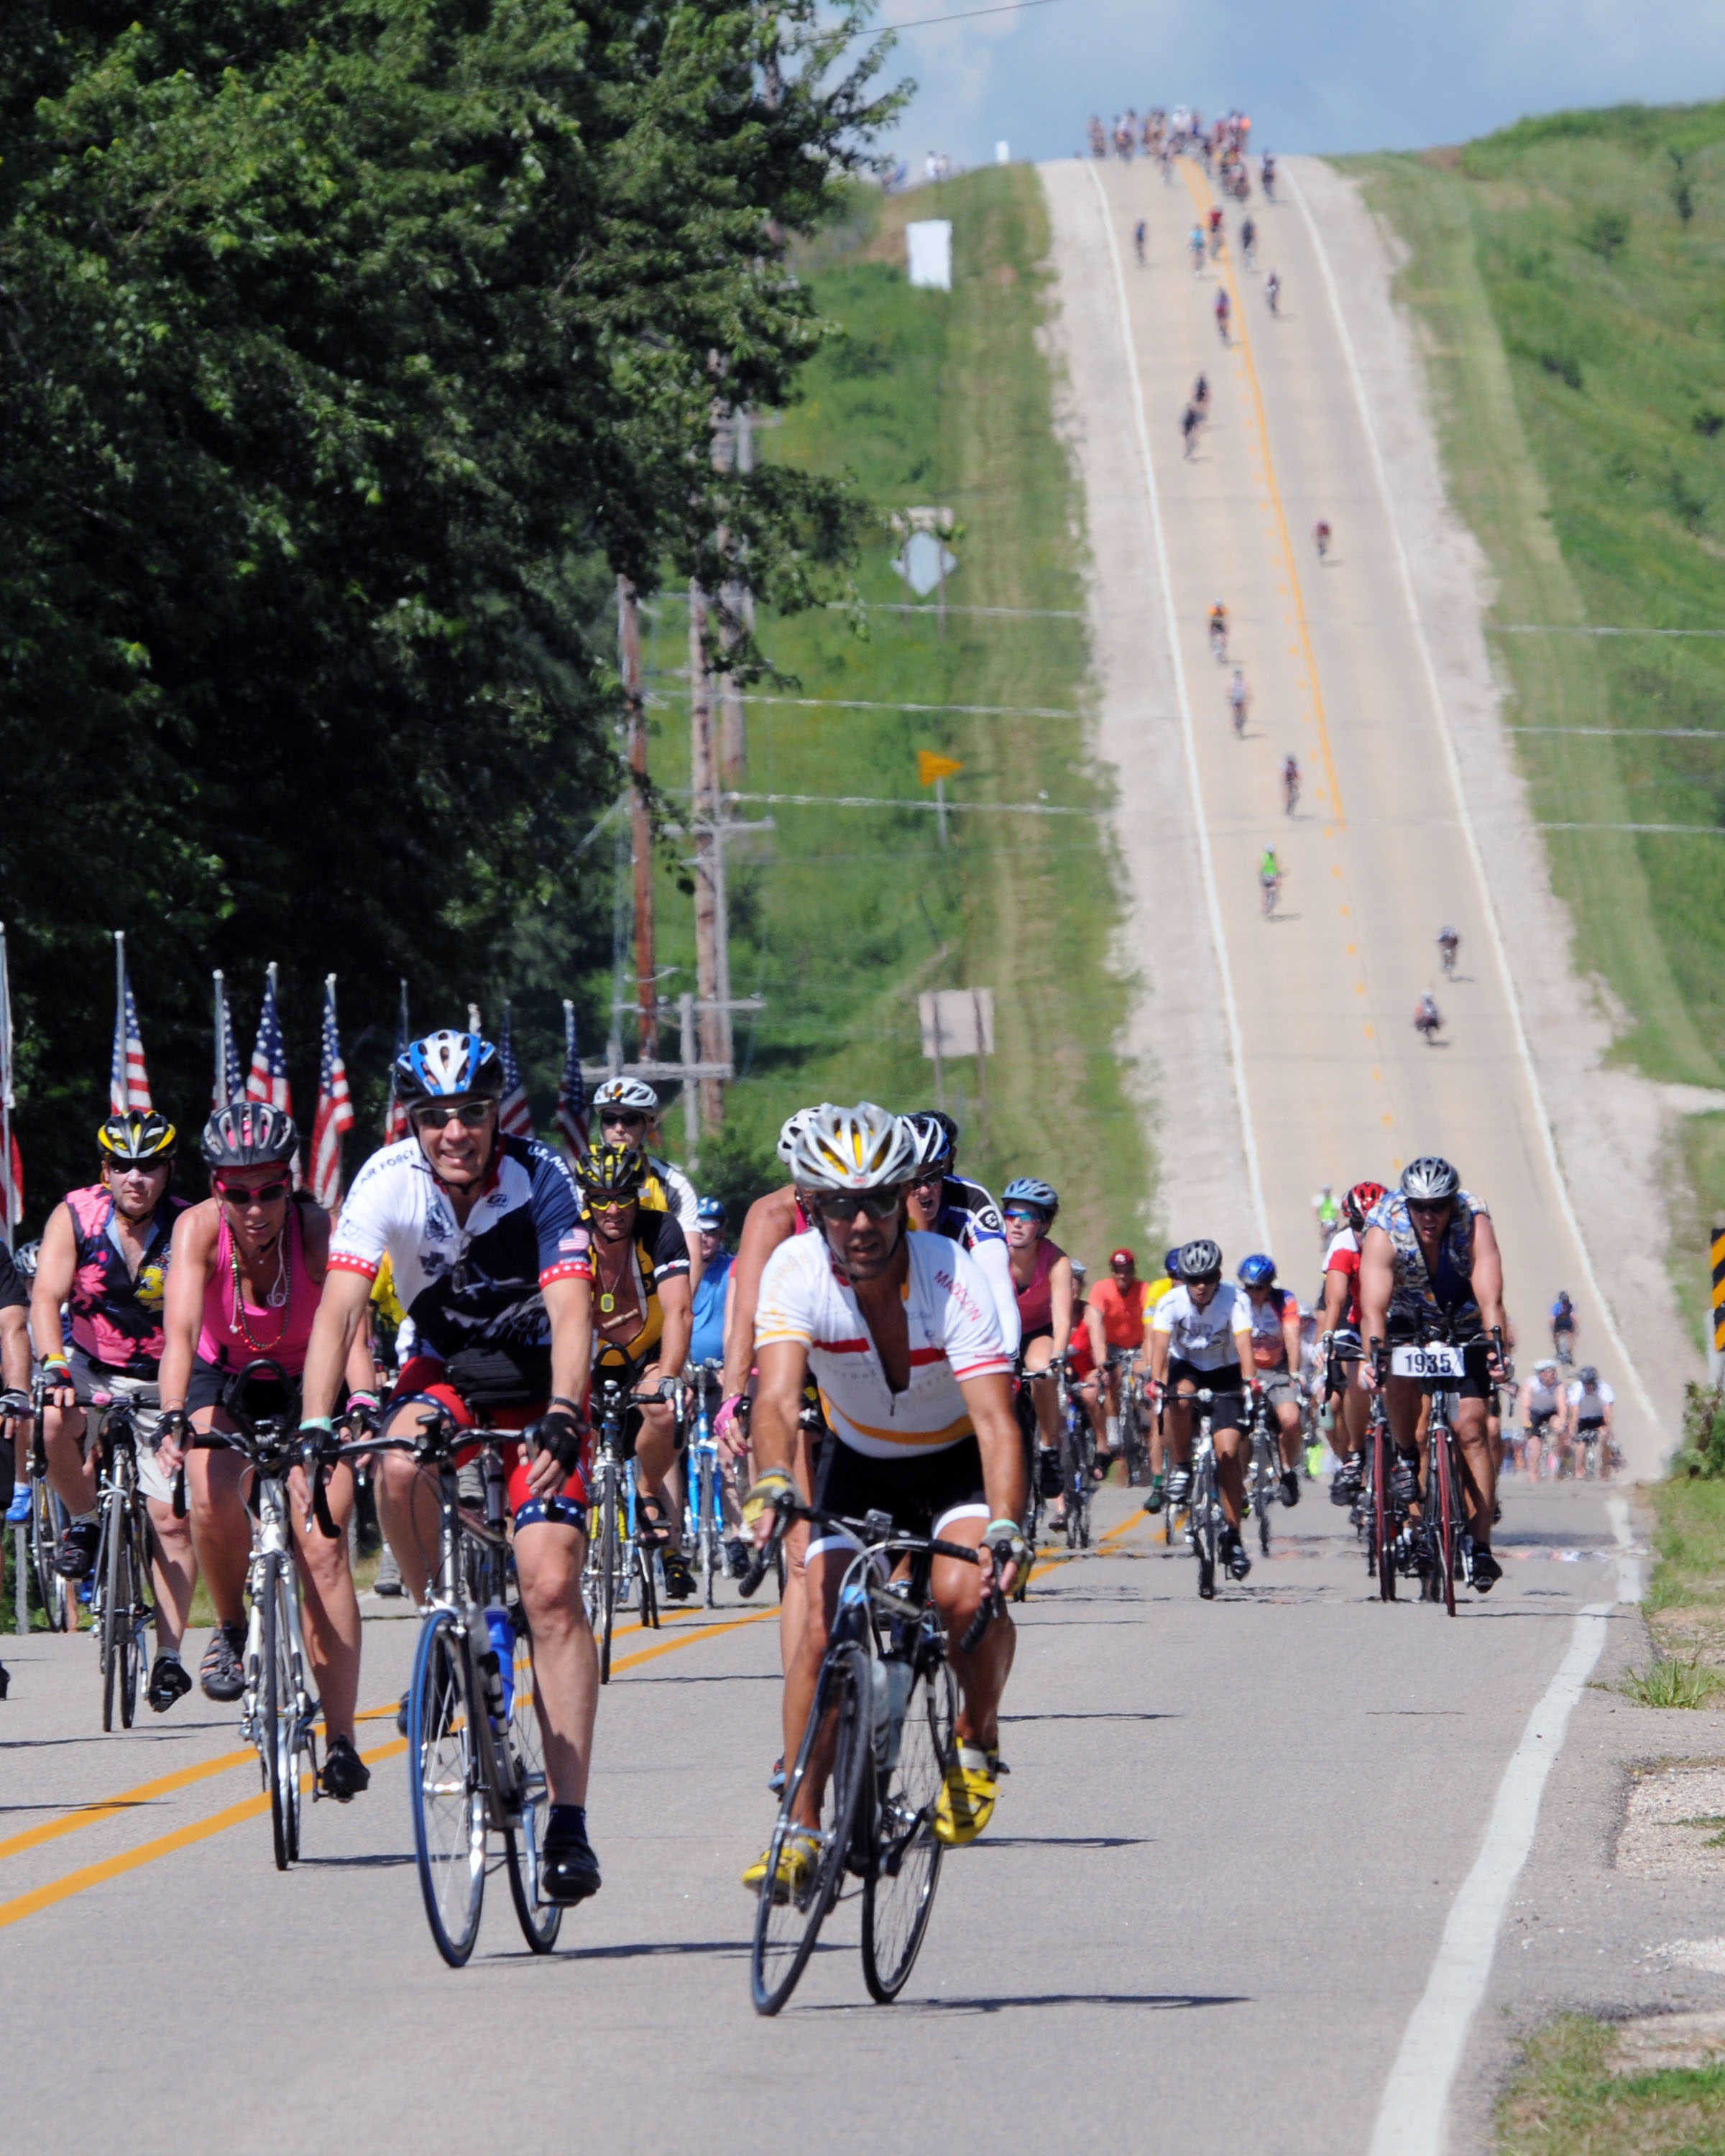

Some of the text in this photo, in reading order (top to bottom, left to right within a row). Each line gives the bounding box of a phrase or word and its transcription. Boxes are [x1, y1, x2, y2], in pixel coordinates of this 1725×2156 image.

[528, 1145, 548, 1161] U.S.
[550, 1156, 569, 1176] AIR
[1404, 1353, 1451, 1373] 1935
